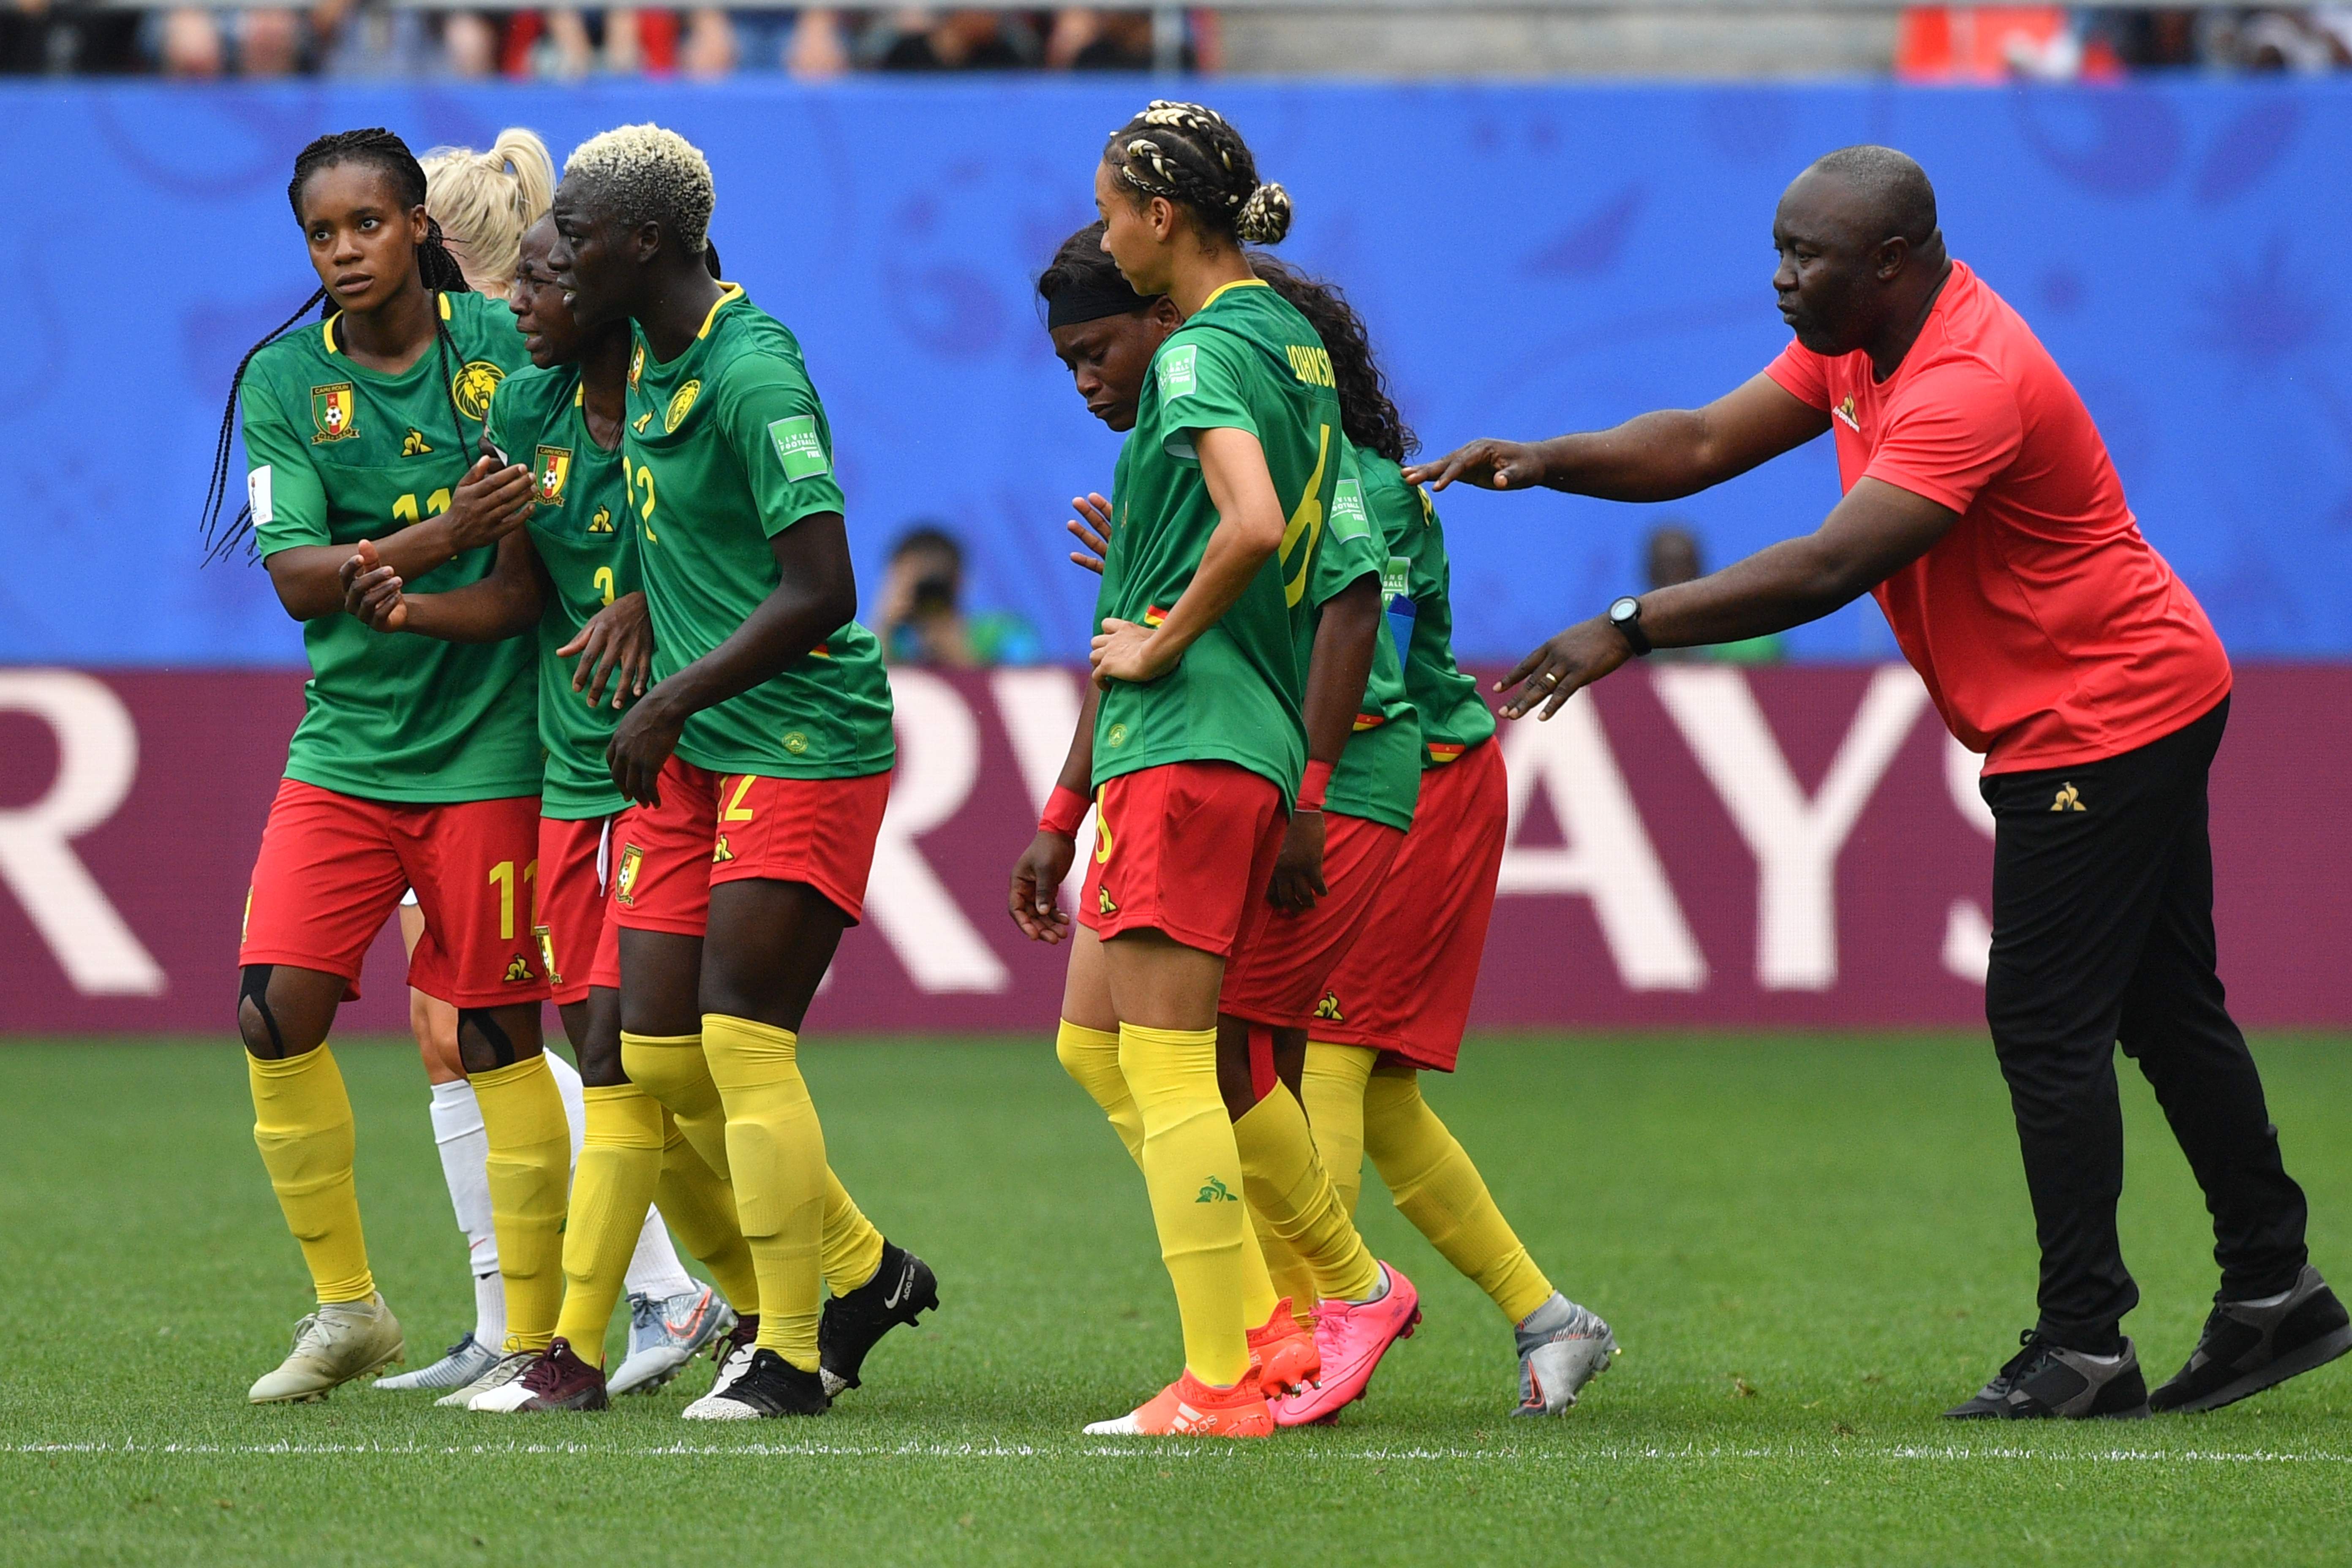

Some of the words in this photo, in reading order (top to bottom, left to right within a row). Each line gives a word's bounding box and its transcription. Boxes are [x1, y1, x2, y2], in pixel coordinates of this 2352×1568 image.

[1285, 345, 1336, 389] JOHNSO
[778, 432, 814, 445] LIVING
[780, 439, 816, 452] FOOTBALL
[489, 859, 538, 940] 11
[1188, 1414, 1218, 1436] das
